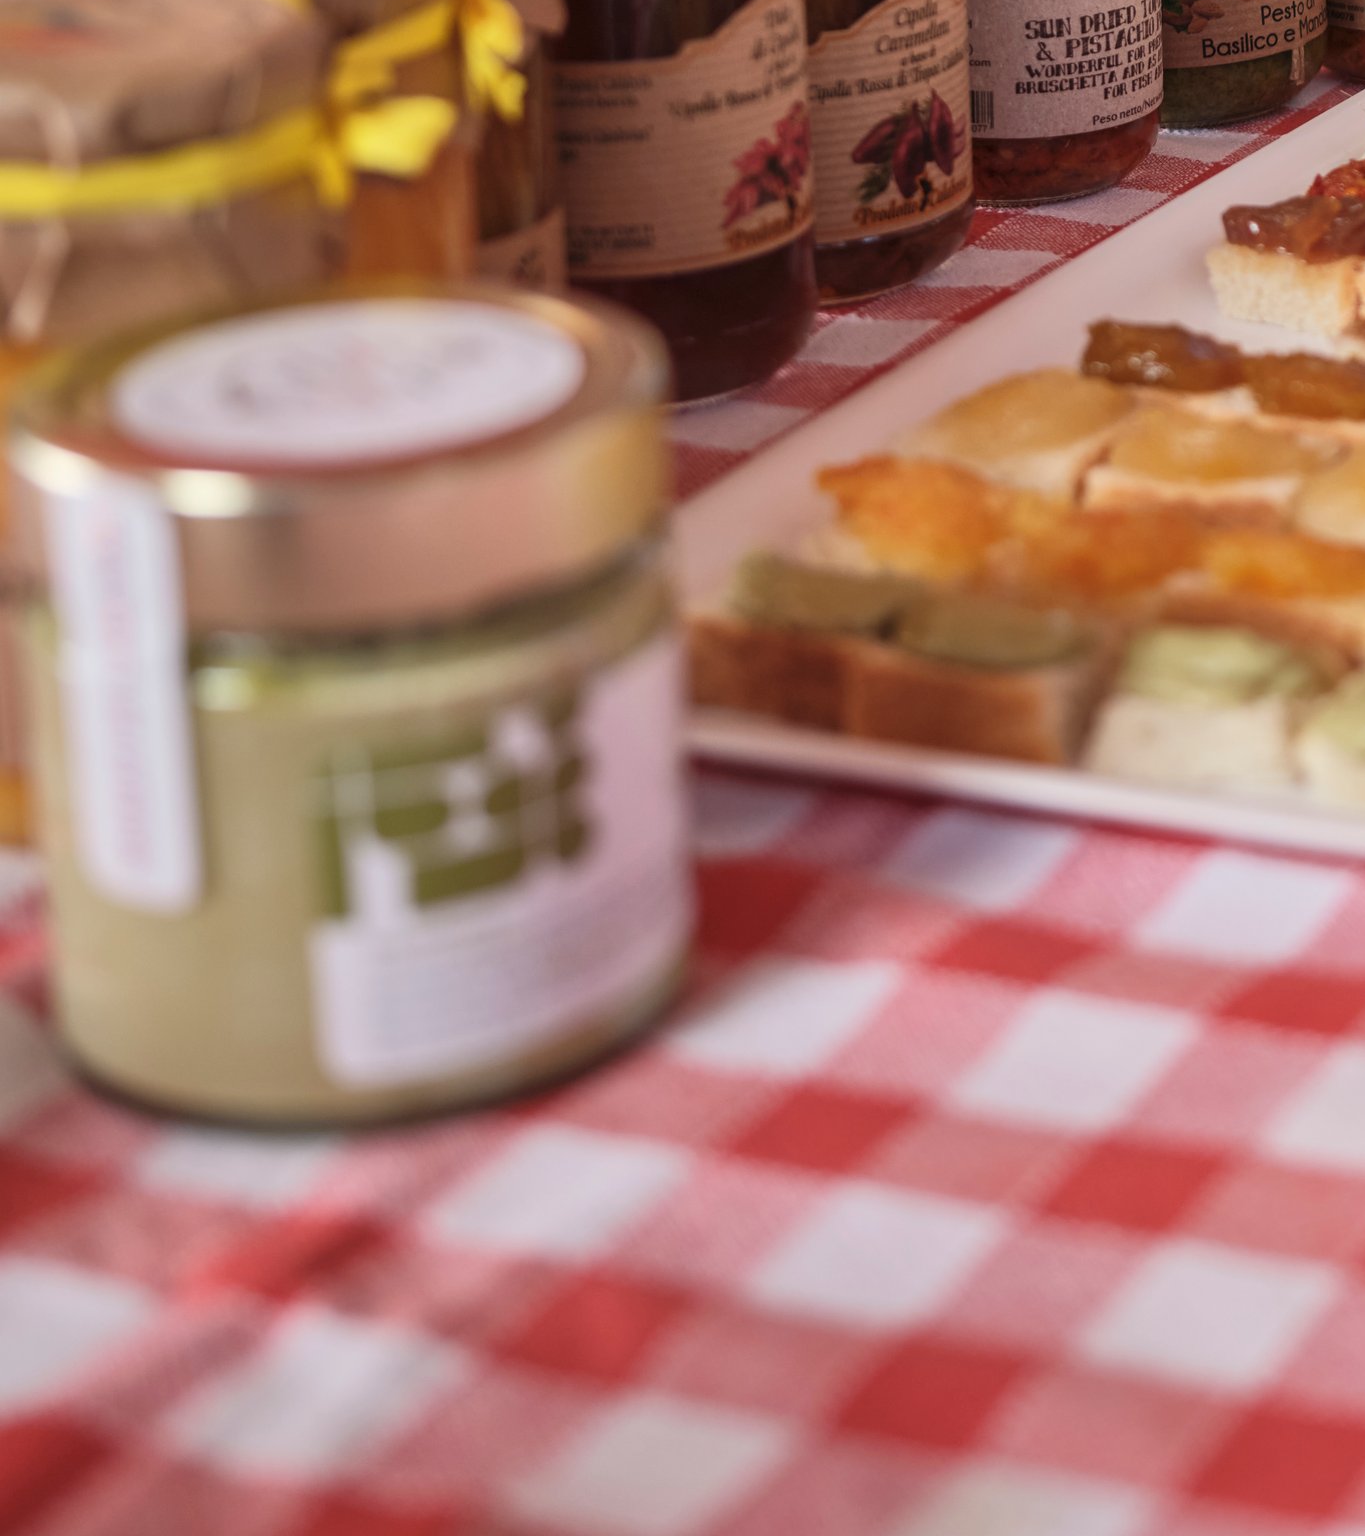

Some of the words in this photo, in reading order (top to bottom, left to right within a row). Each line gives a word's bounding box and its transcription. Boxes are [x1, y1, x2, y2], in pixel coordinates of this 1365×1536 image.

[1024, 17, 1071, 40] SUN
[1080, 5, 1137, 34] DRIED
[1260, 0, 1305, 26] Pesto
[1035, 41, 1055, 62] &
[1065, 15, 1155, 59] PISTACHIO
[1201, 31, 1279, 59] Basilico
[1284, 27, 1295, 43] e
[1015, 70, 1118, 95] BRUSCHETTA
[1122, 61, 1145, 81] AND
[1025, 53, 1123, 79] WONDERFUL
[1127, 44, 1145, 64] FOR
[1103, 84, 1128, 100] FOR
[1131, 72, 1153, 93] FISH
[1092, 113, 1118, 126] Peso
